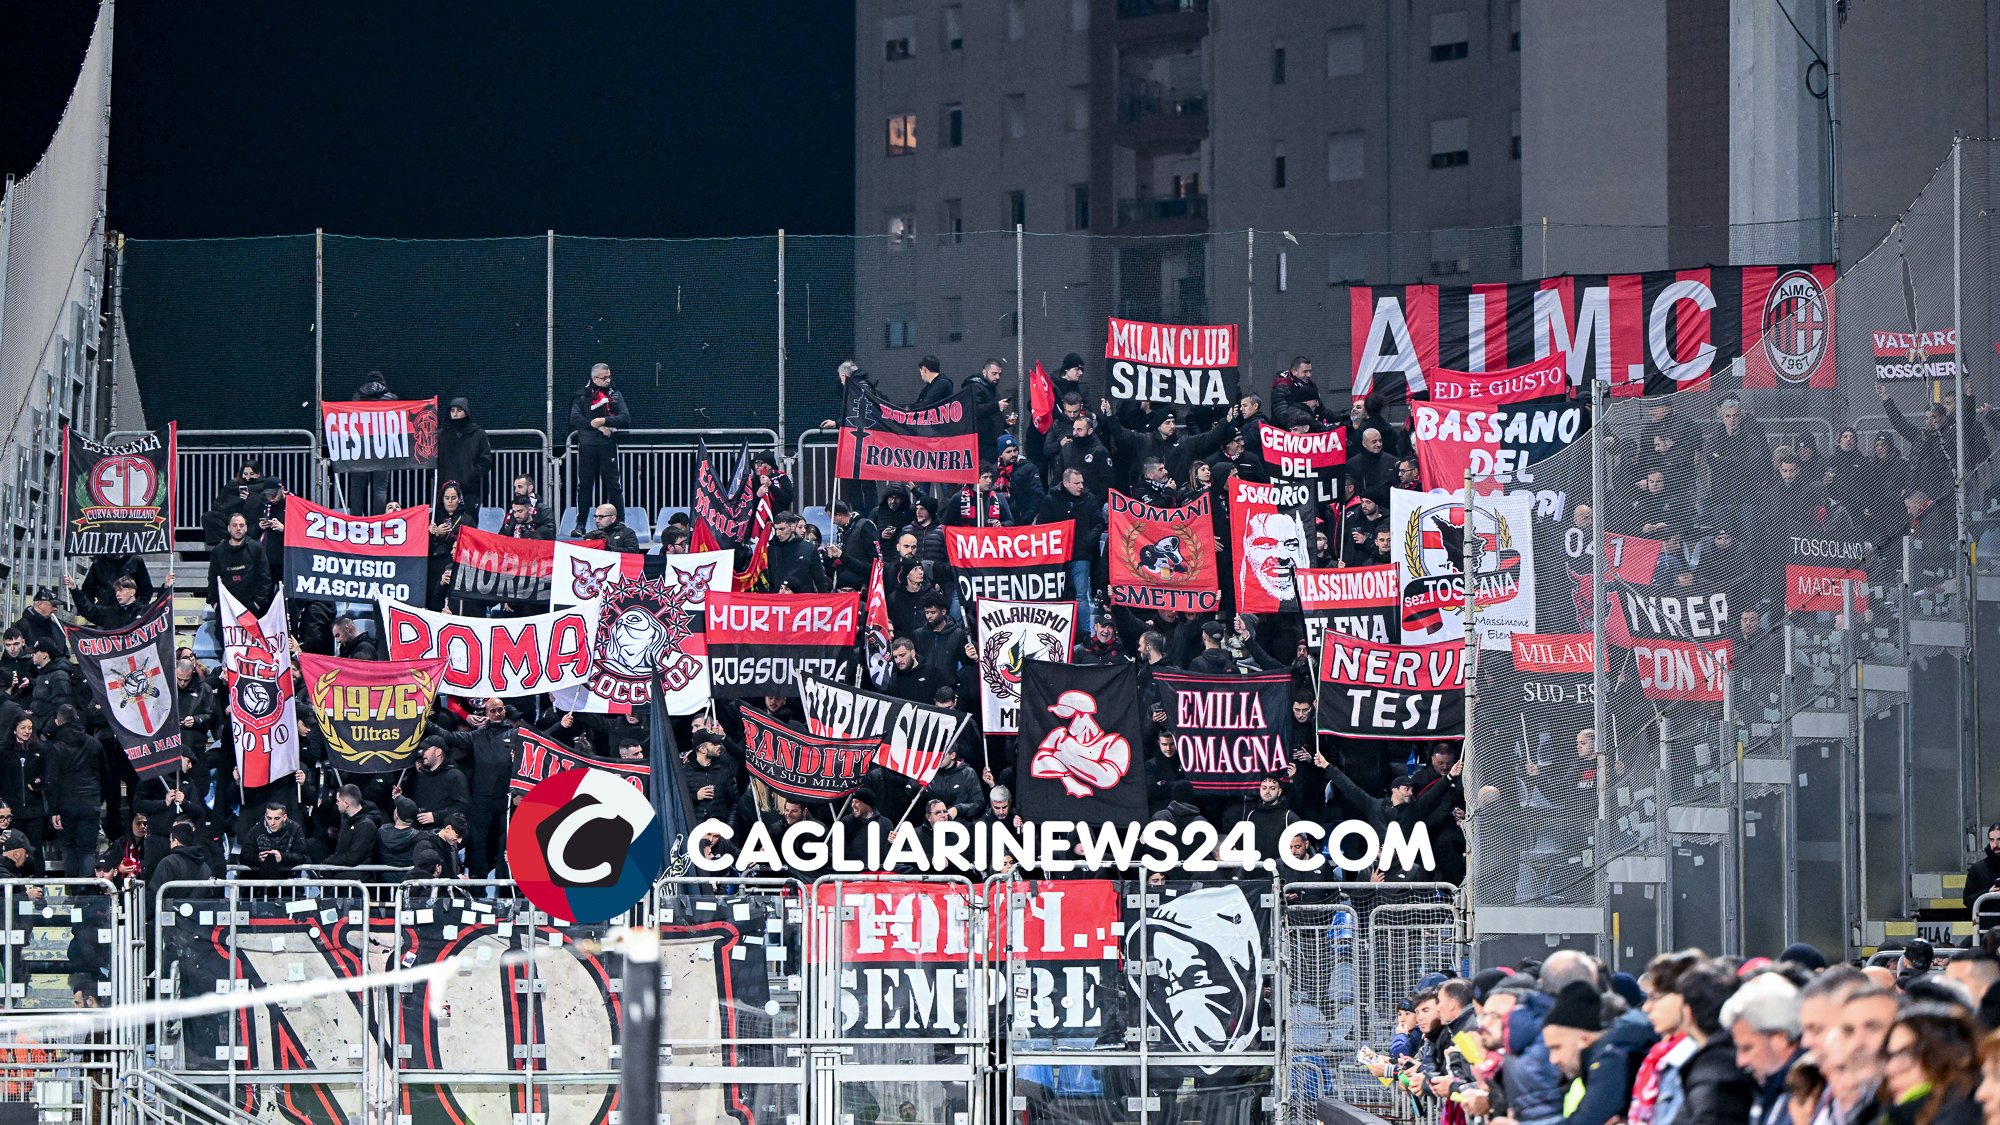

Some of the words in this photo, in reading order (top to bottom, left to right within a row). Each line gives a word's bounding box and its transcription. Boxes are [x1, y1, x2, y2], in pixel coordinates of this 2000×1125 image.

[1780, 285, 1815, 299] AIMC
[1111, 320, 1176, 364] MILAN
[1180, 328, 1229, 366] CLUB
[1110, 361, 1229, 405] SIENA
[1434, 382, 1463, 399] ED
[1469, 379, 1483, 397] È
[1489, 367, 1562, 396] GIUSTO
[326, 410, 409, 461] GESTURI
[1416, 407, 1581, 443] BASSANO
[1260, 426, 1343, 454] GEMONA
[866, 445, 973, 470] ROSSONERA
[1281, 456, 1318, 478] DEL
[1469, 449, 1534, 483] DEL
[87, 508, 111, 520] CURVA
[113, 508, 127, 519] SUD
[129, 508, 155, 519] MILANO
[1110, 491, 1209, 522] DOMANI
[69, 528, 168, 554] MILITANZA
[305, 511, 407, 545] 20813
[956, 529, 1062, 559] MARCHE
[1790, 537, 1862, 560] TOSCOLANO
[312, 554, 396, 578] BOVISIO
[296, 575, 409, 601] MASCIAGO
[1113, 585, 1216, 610] SMETTO
[709, 604, 853, 632] MORTARA
[981, 606, 1069, 633] MILANISMO
[1475, 615, 1529, 628] Massimone
[388, 606, 594, 692] ROMA
[1487, 630, 1511, 640] Elen
[1634, 645, 1695, 692] CON
[332, 684, 418, 721] 1976
[1523, 682, 1607, 703] SUD-ES
[1176, 690, 1267, 729] EMILIA
[1347, 688, 1442, 729] TESI
[351, 725, 400, 741] Ultras
[886, 702, 957, 788] SUD
[1175, 734, 1289, 774] OMAGNA
[781, 769, 807, 784] SUD
[1918, 926, 1941, 943] FILA
[1944, 926, 1951, 943] 6
